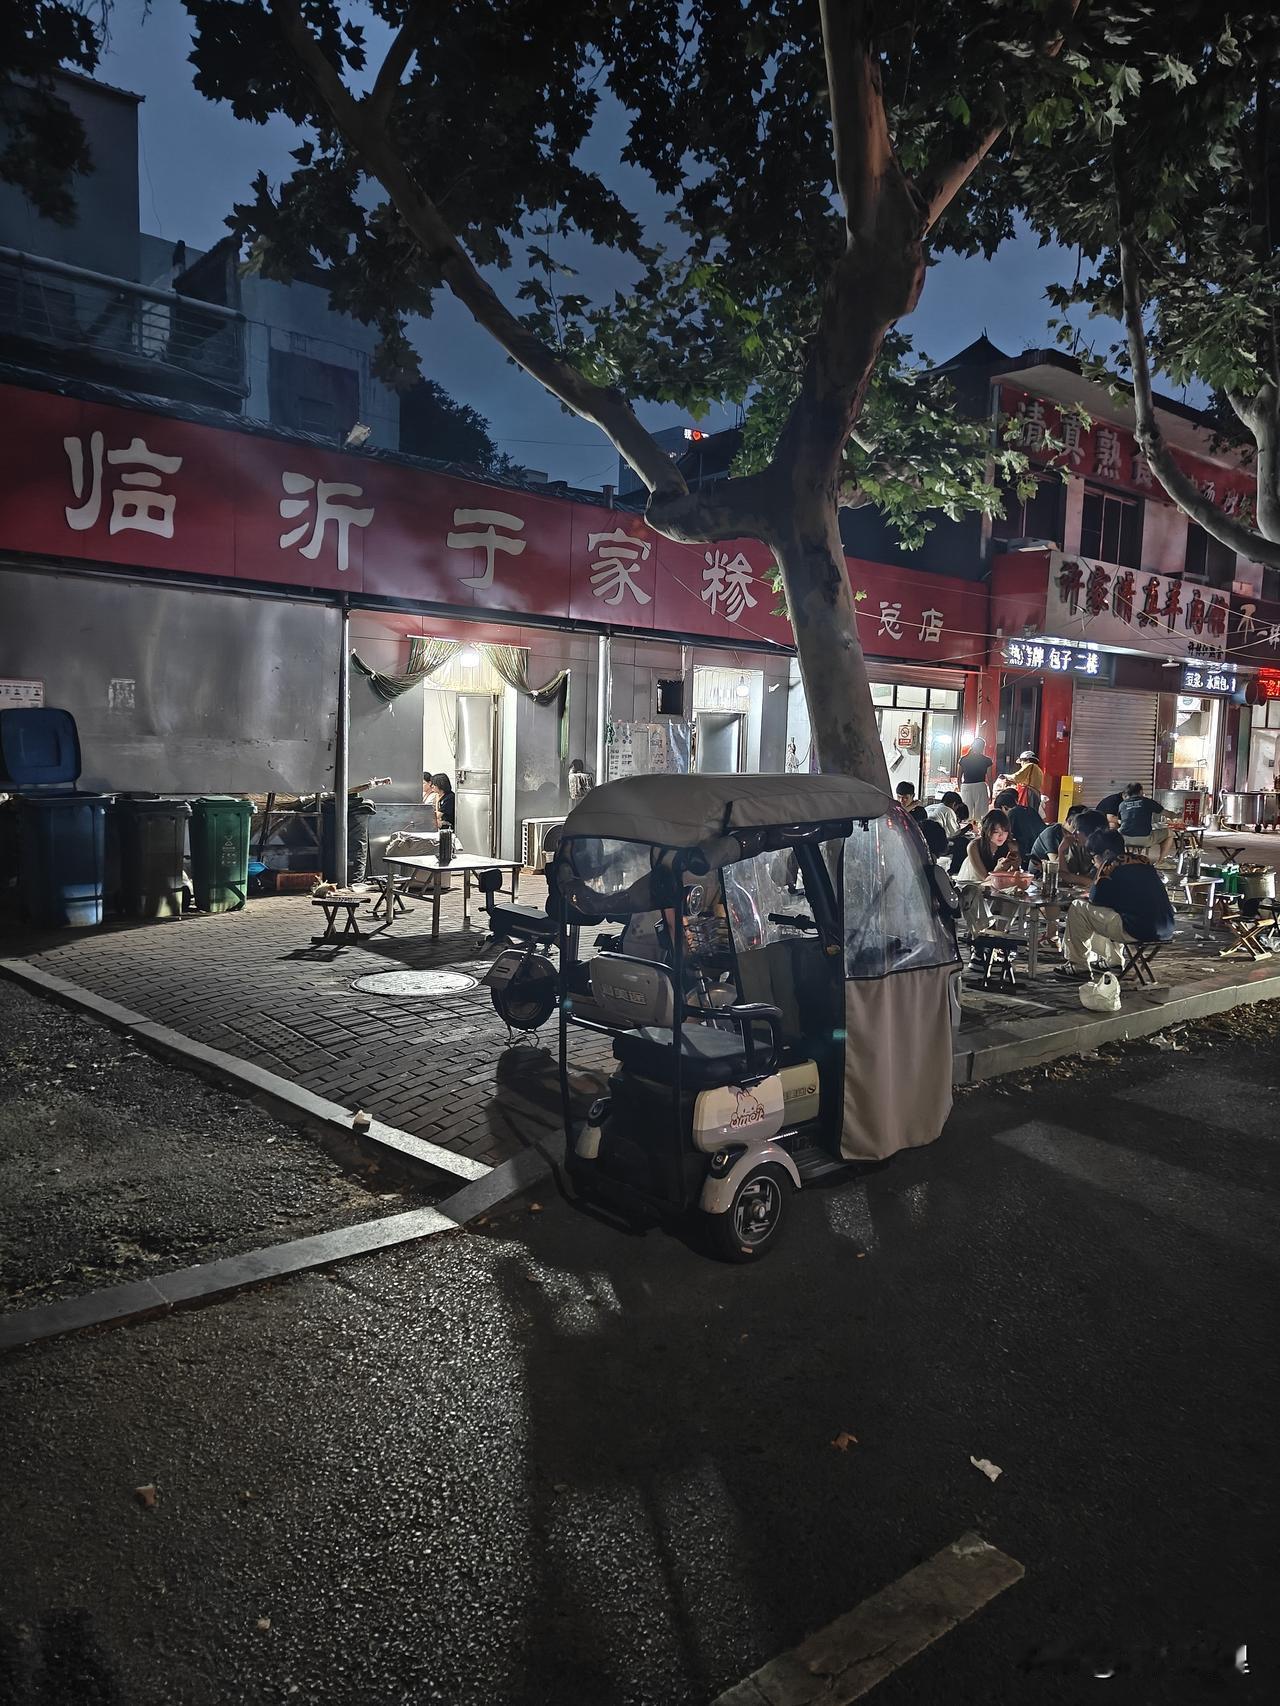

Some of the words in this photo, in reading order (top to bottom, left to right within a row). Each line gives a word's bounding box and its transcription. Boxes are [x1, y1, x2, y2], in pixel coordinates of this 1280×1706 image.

[63, 430, 759, 623] 临沂于家糁
[878, 601, 945, 643] 总店
[1049, 647, 1073, 671] 包子
